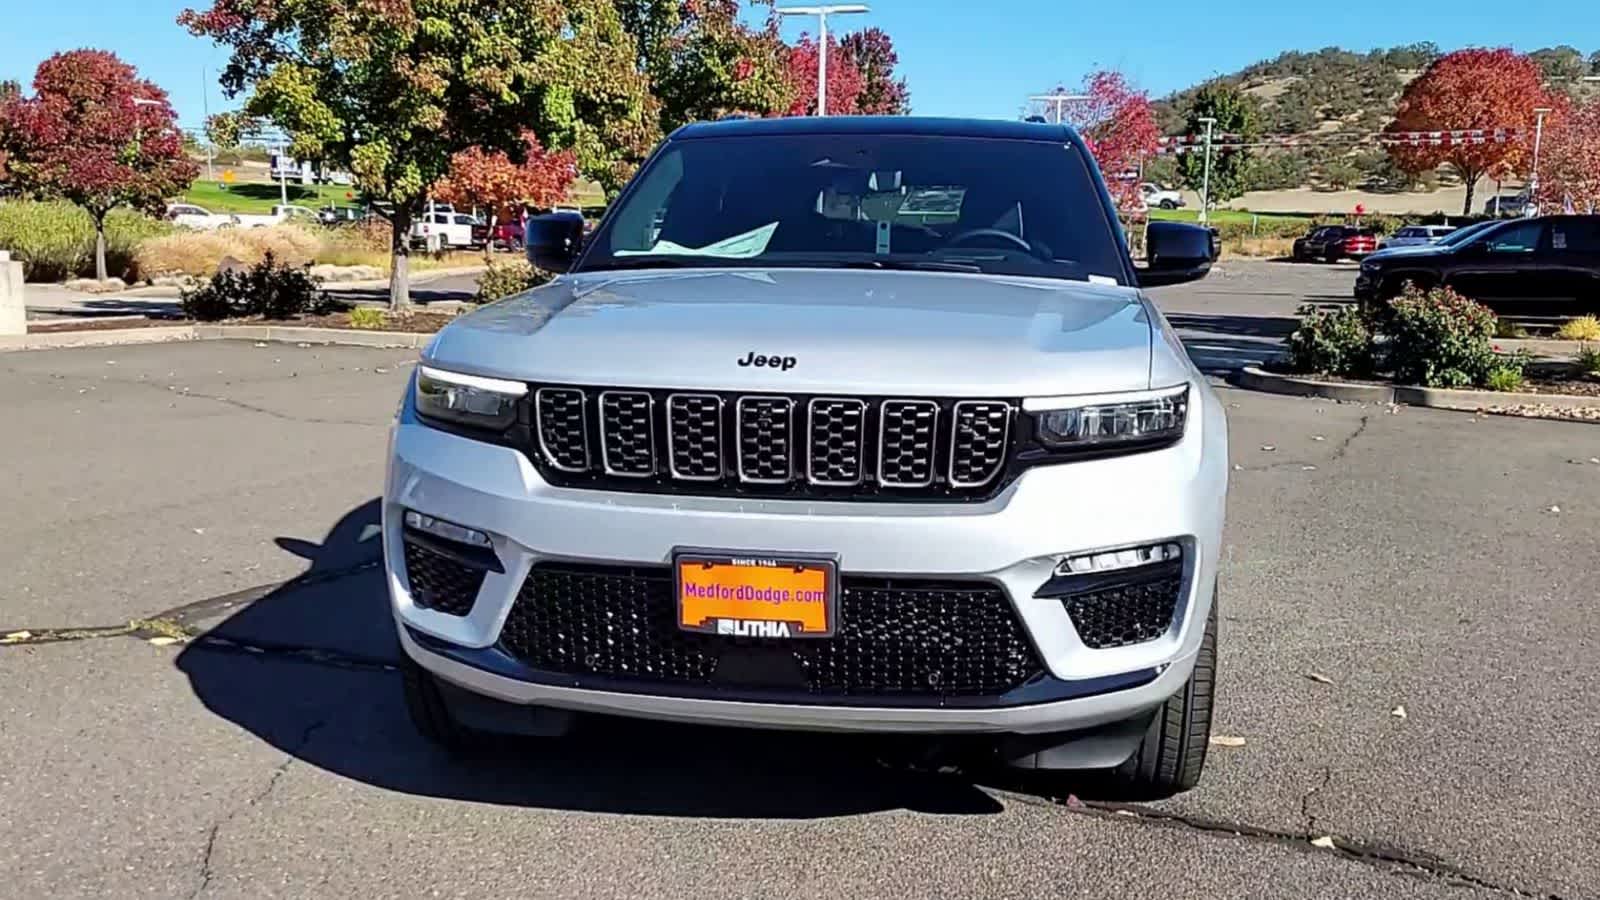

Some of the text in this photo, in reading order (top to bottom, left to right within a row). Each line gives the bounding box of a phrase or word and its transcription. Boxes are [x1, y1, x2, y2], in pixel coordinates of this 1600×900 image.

[737, 351, 797, 371] Jeep
[732, 558, 756, 567] SINCE
[685, 582, 826, 604] MedfordDodge.com
[734, 619, 790, 638] LITHIA
